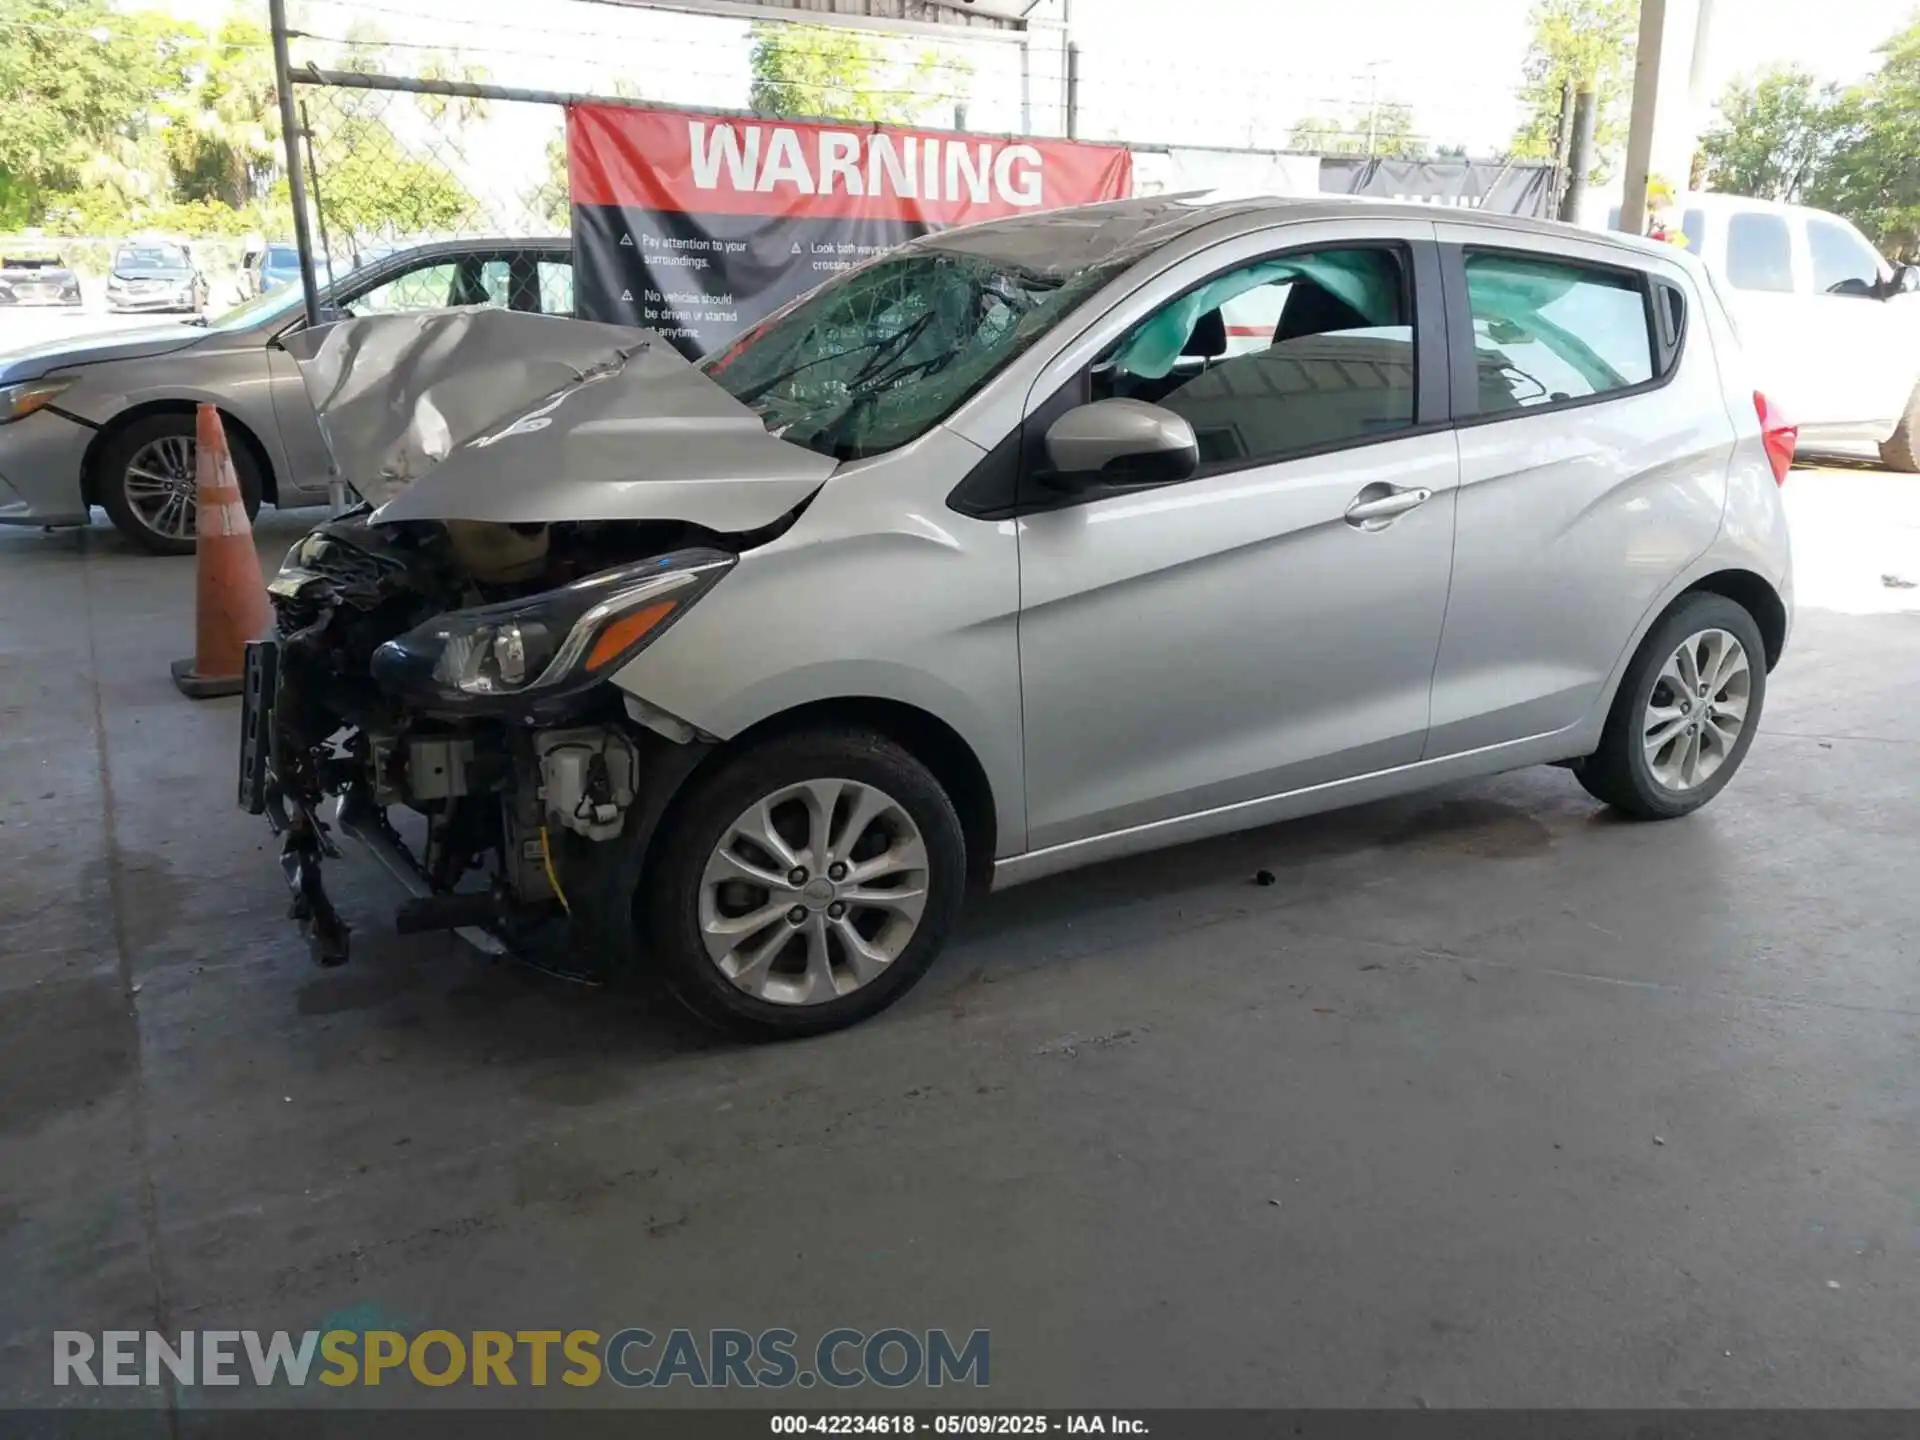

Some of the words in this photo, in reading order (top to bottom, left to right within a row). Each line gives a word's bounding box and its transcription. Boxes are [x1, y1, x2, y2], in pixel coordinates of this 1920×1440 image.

[688, 120, 1043, 207] WARNING
[642, 233, 660, 249] Pay
[662, 238, 711, 251] attention
[712, 240, 723, 251] to
[725, 242, 747, 254] your
[811, 241, 835, 254] Look
[837, 242, 856, 255] both
[643, 254, 711, 269] surroundings.
[644, 289, 661, 302] No
[664, 291, 700, 304] vehicles
[701, 292, 732, 305] should
[644, 307, 659, 319] be
[661, 308, 692, 321] driven
[704, 310, 738, 321] started
